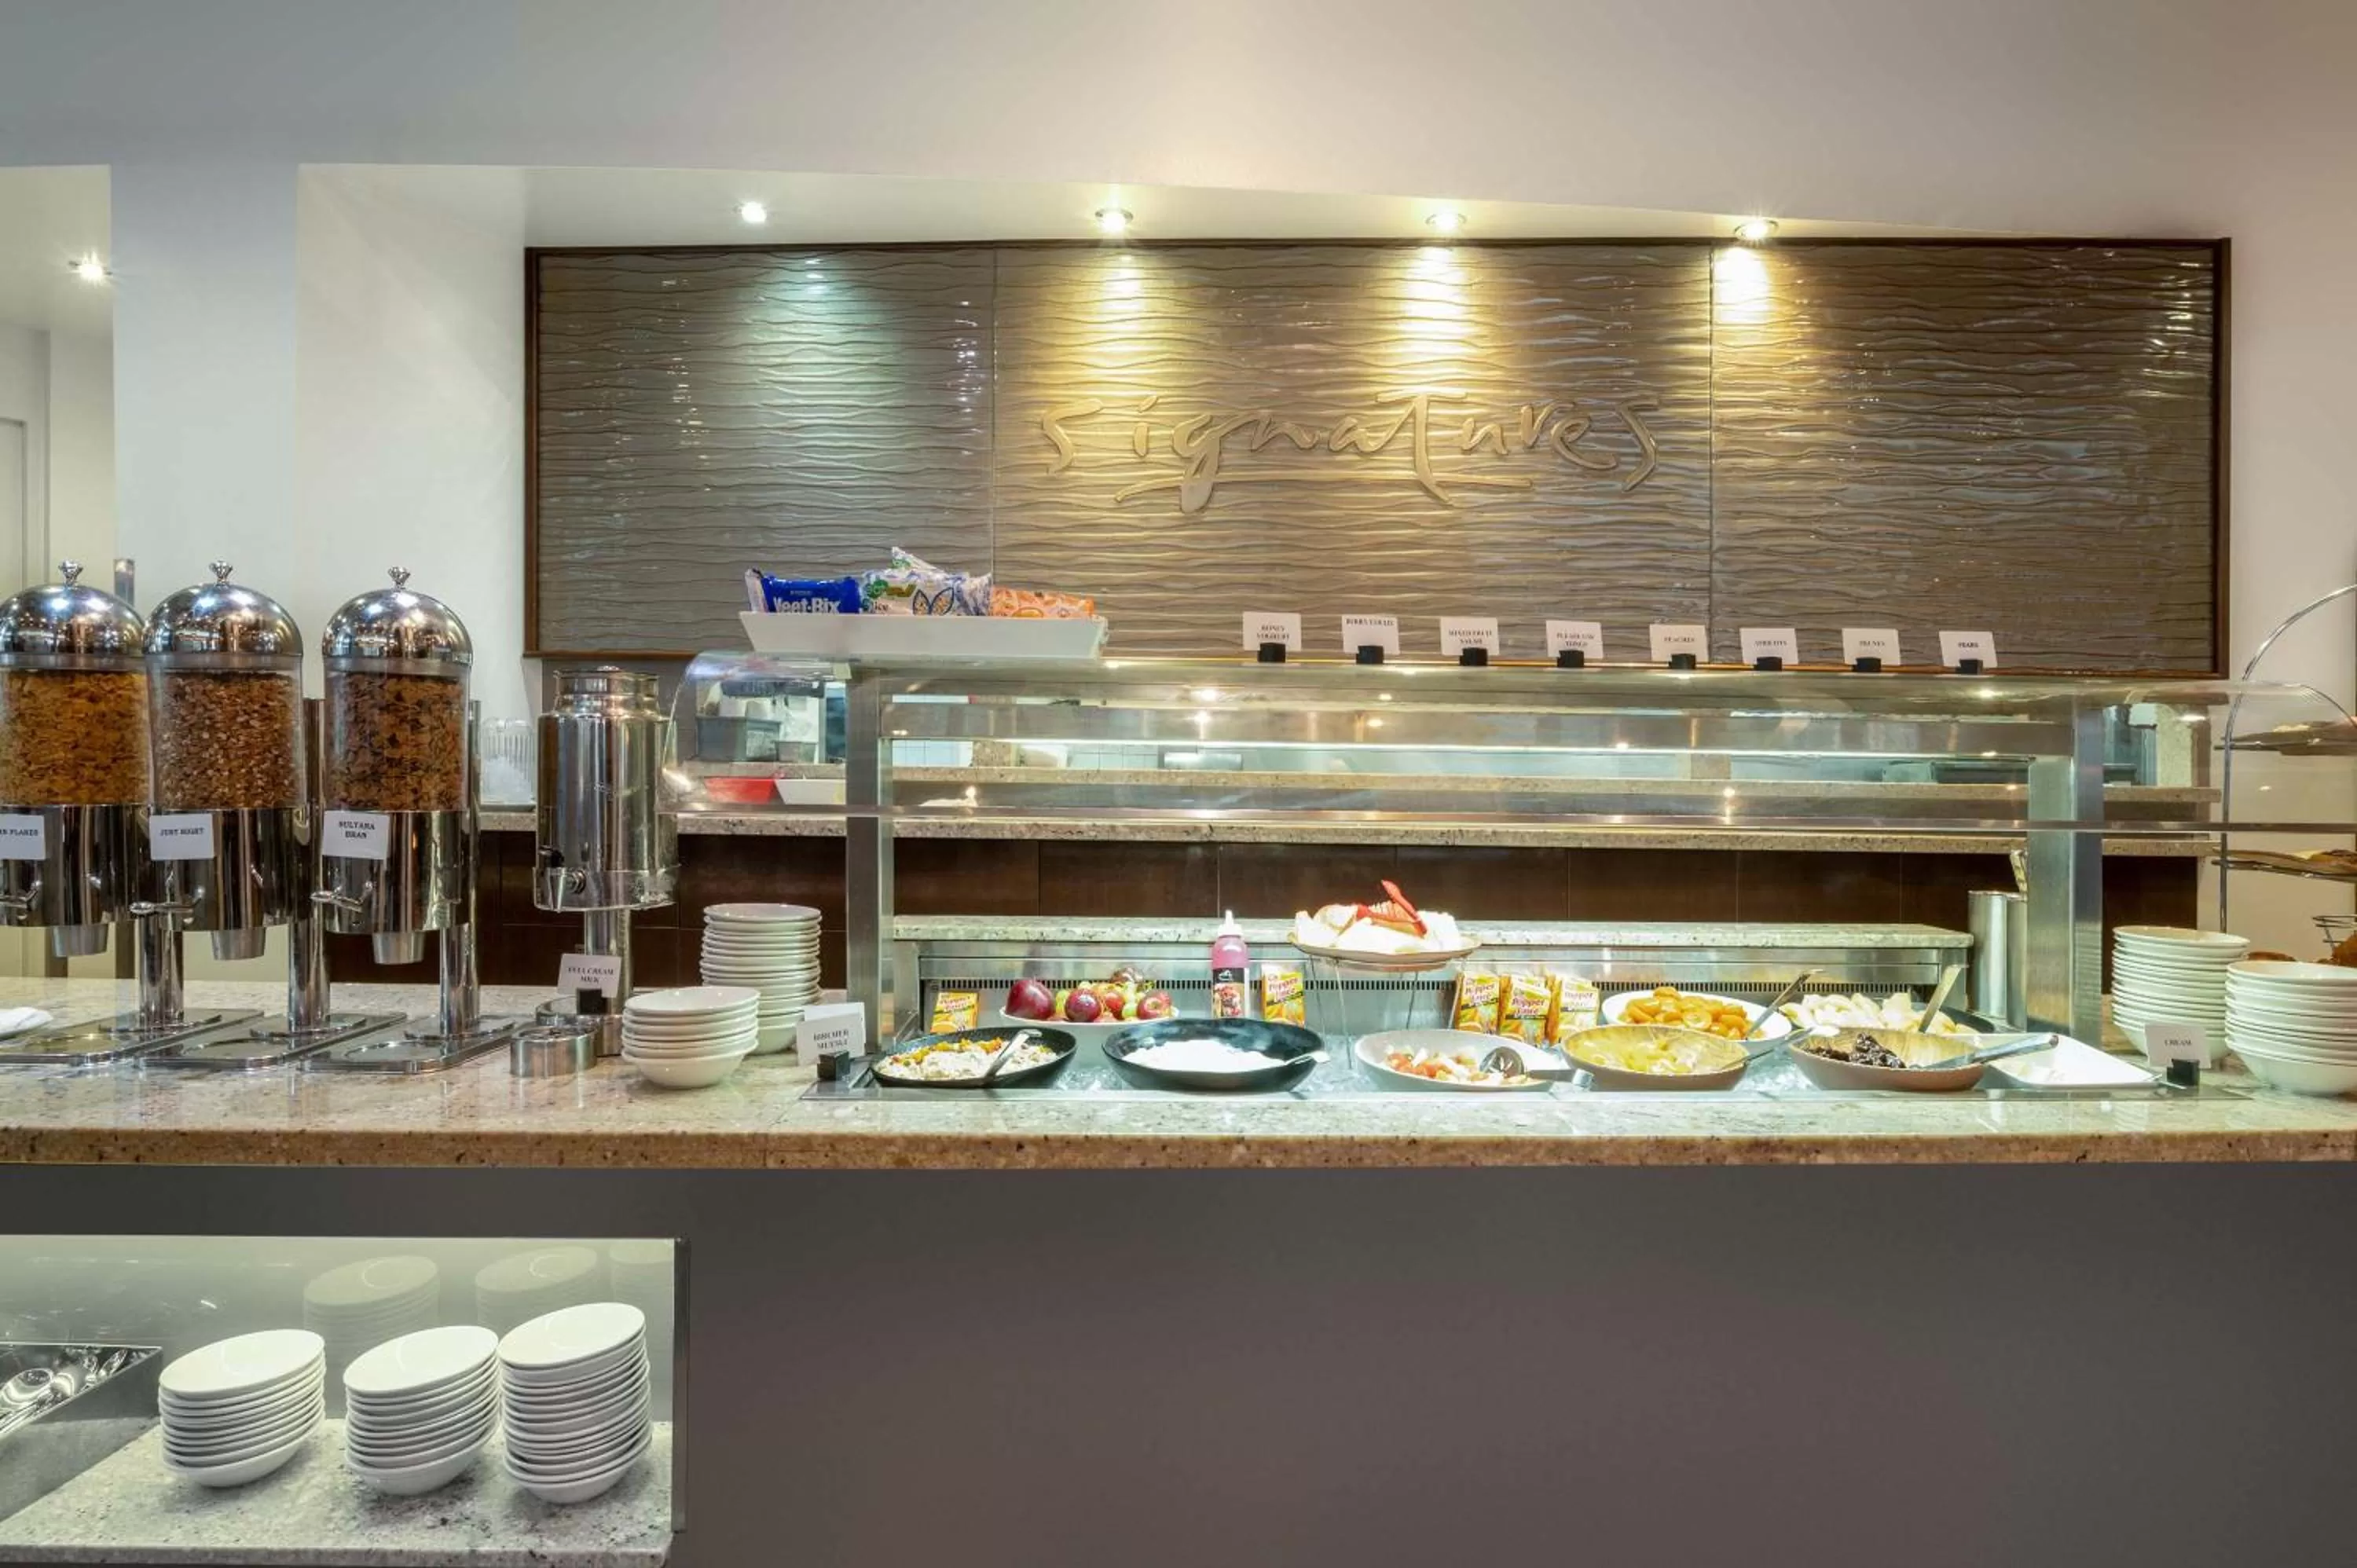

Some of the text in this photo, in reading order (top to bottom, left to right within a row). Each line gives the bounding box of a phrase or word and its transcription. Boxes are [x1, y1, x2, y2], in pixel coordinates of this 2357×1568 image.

[1041, 387, 1661, 512] Signatures
[339, 821, 376, 830] SULTANA
[2165, 1039, 2192, 1048] CREAM
